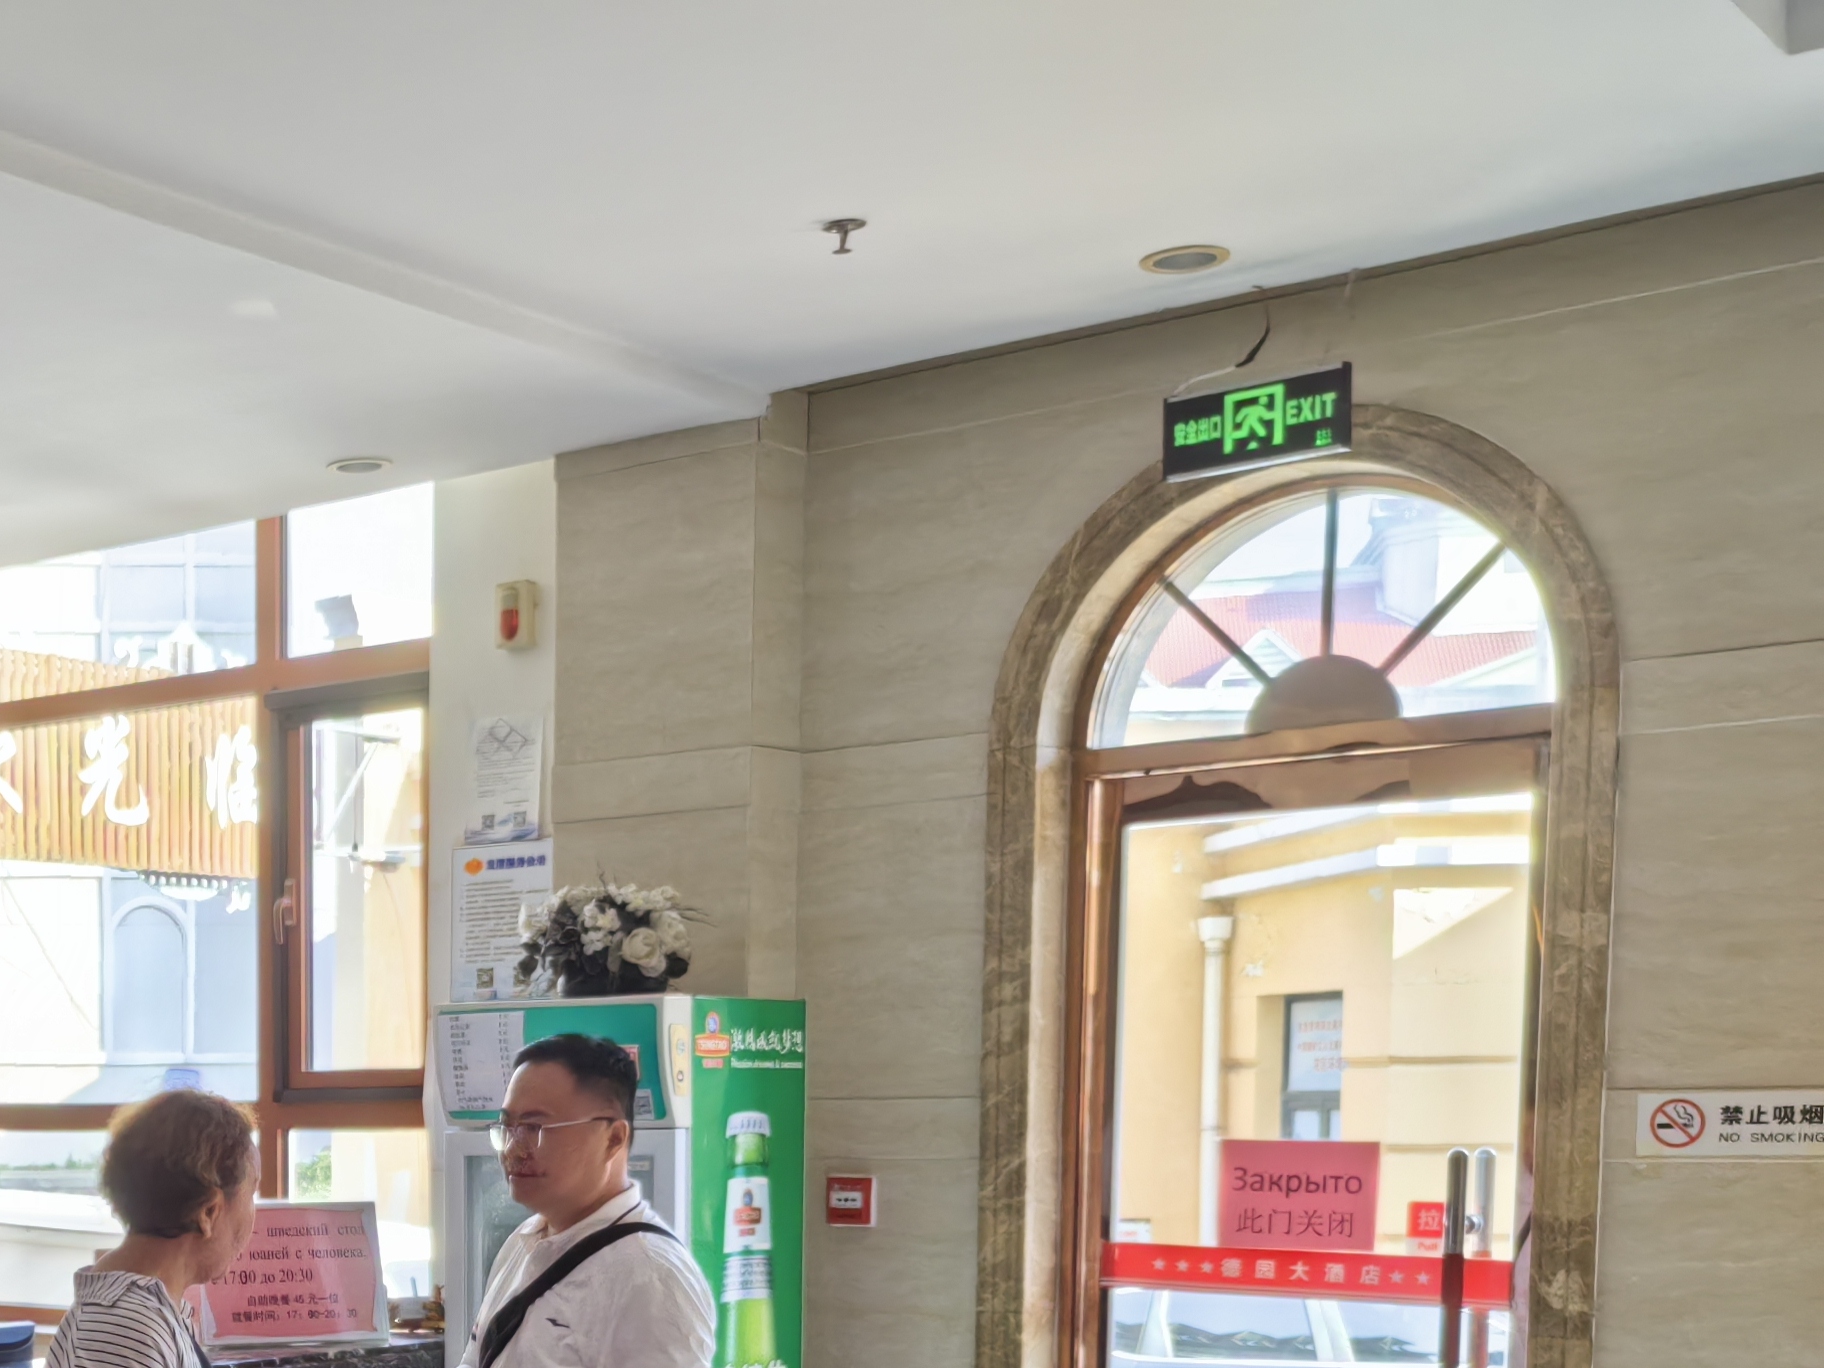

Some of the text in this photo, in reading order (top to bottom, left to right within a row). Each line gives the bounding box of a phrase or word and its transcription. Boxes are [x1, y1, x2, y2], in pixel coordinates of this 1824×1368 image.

[1286, 392, 1337, 425] EXIT
[1174, 415, 1221, 446] 安全出口
[1720, 1105, 1824, 1125] 禁止吸烟
[1719, 1132, 1824, 1143] NO SMOKING
[1233, 1167, 1362, 1198] Закрыто
[1235, 1207, 1353, 1237] 此门关闭
[1417, 1209, 1441, 1231] 拉
[250, 1247, 289, 1261] юаней
[260, 1274, 276, 1283] до
[279, 1268, 313, 1283] 20:30
[1222, 1257, 1381, 1285] 德园大酒店
